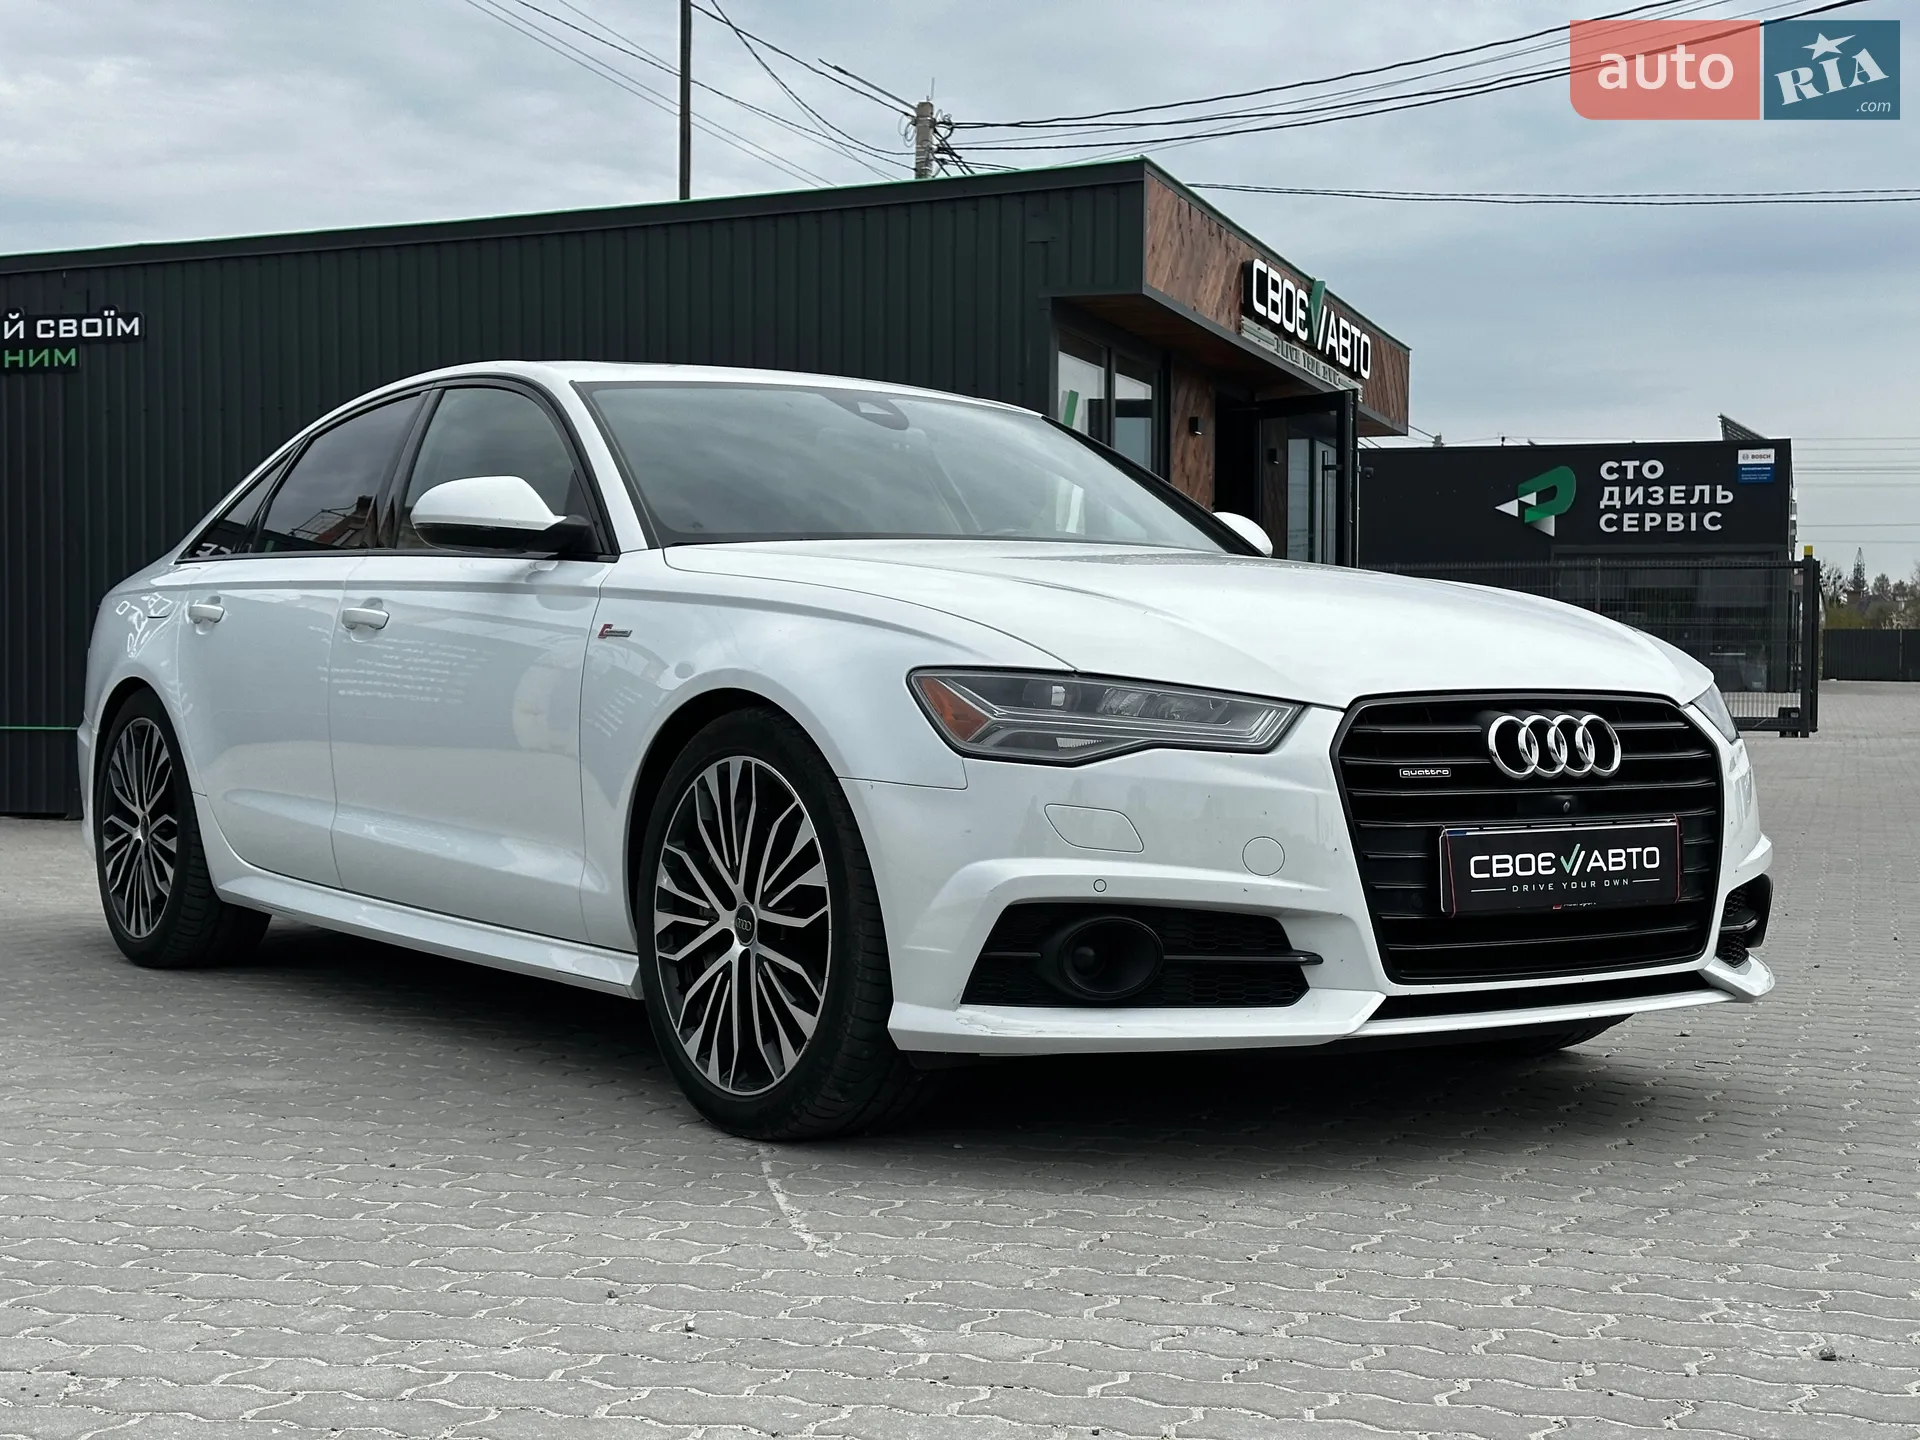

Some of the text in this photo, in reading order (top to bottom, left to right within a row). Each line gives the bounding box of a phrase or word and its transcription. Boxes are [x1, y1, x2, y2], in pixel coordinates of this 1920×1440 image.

[36, 310, 140, 339] СВОЇМ
[1325, 310, 1371, 380] АВТО
[1599, 459, 1665, 481] СТО
[1599, 484, 1734, 509] ДИЗЕЛЬ
[1599, 511, 1723, 533] СЕРВІС
[1402, 769, 1450, 777] quattro
[1586, 846, 1661, 873] АВТО
[1511, 878, 1630, 893] DRIVE YOUR OWN
